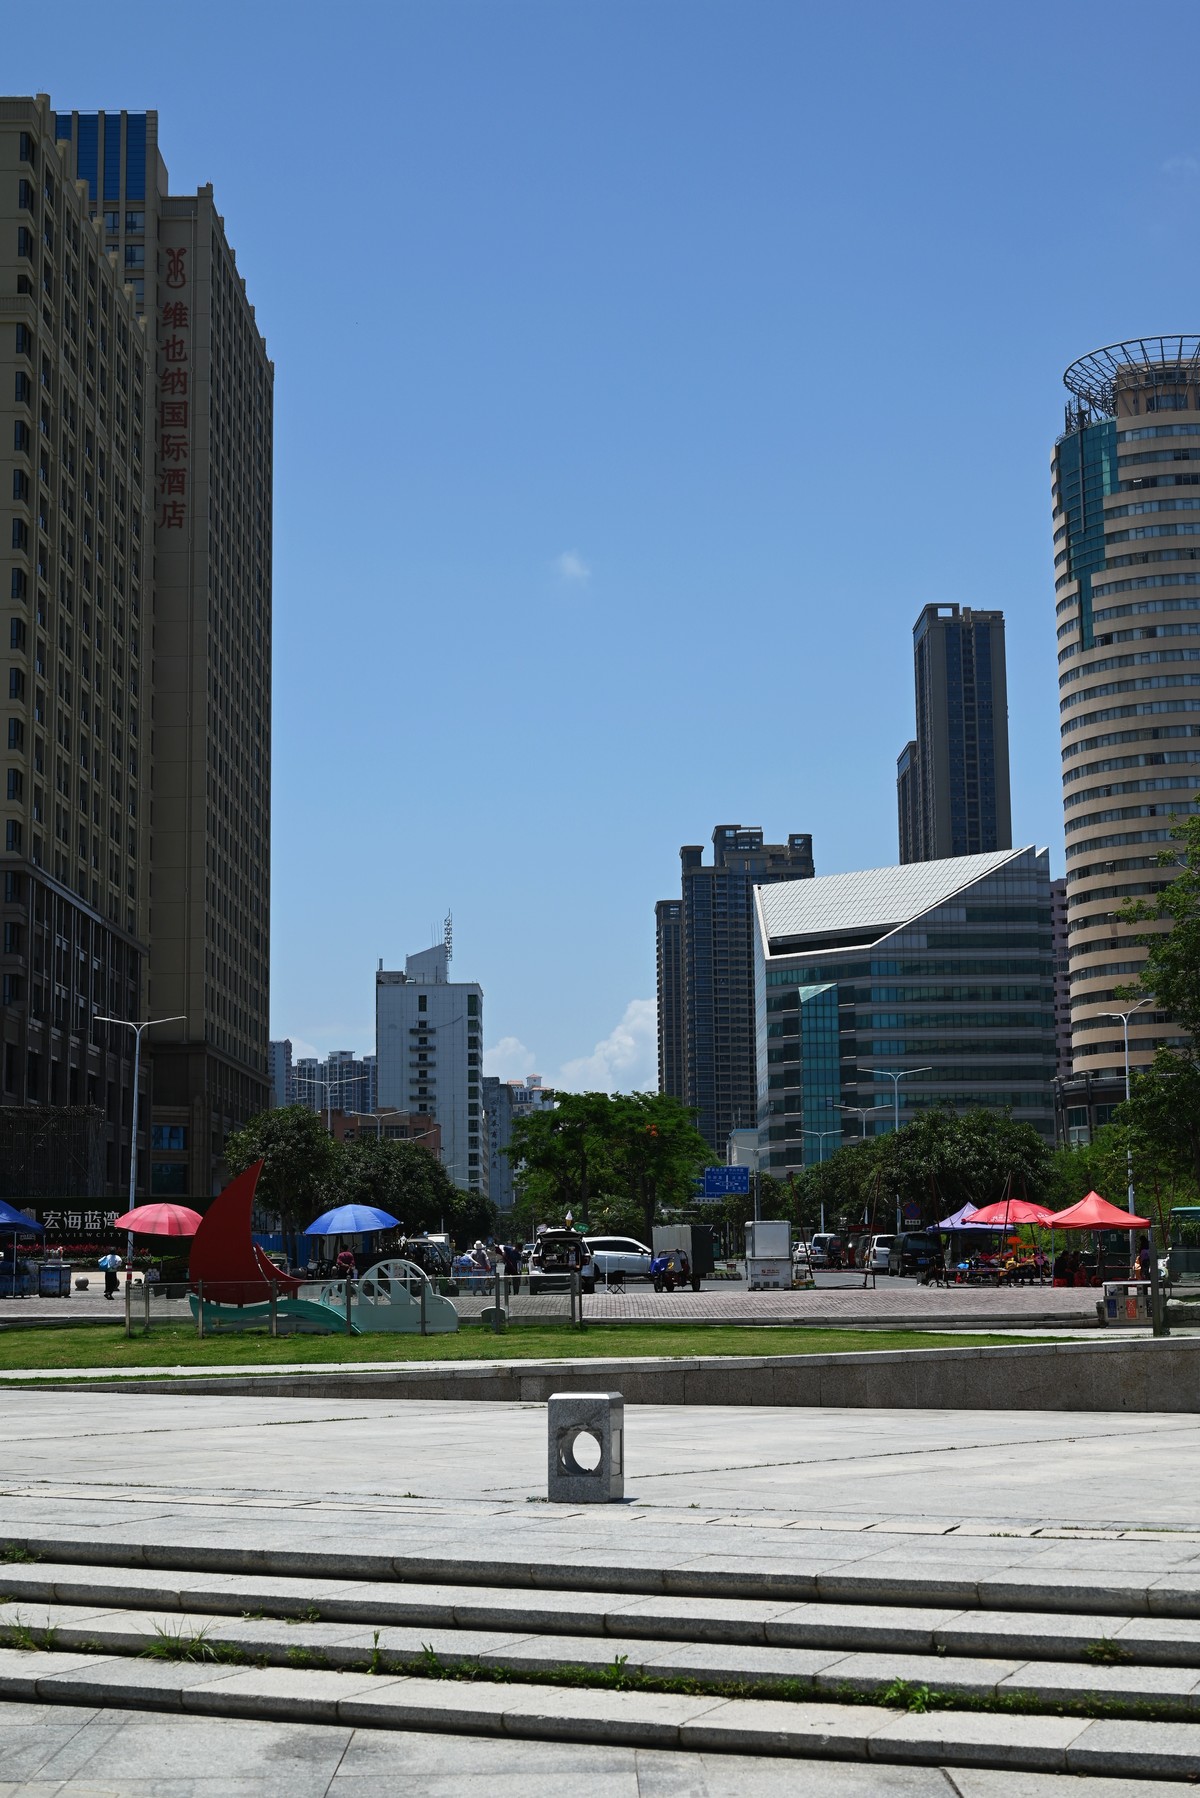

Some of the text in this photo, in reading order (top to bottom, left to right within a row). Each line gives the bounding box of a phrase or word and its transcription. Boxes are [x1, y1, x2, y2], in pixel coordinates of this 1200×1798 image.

[159, 301, 189, 529] 维也纳国际酒店
[42, 1210, 120, 1230] 宏海蓝湾
